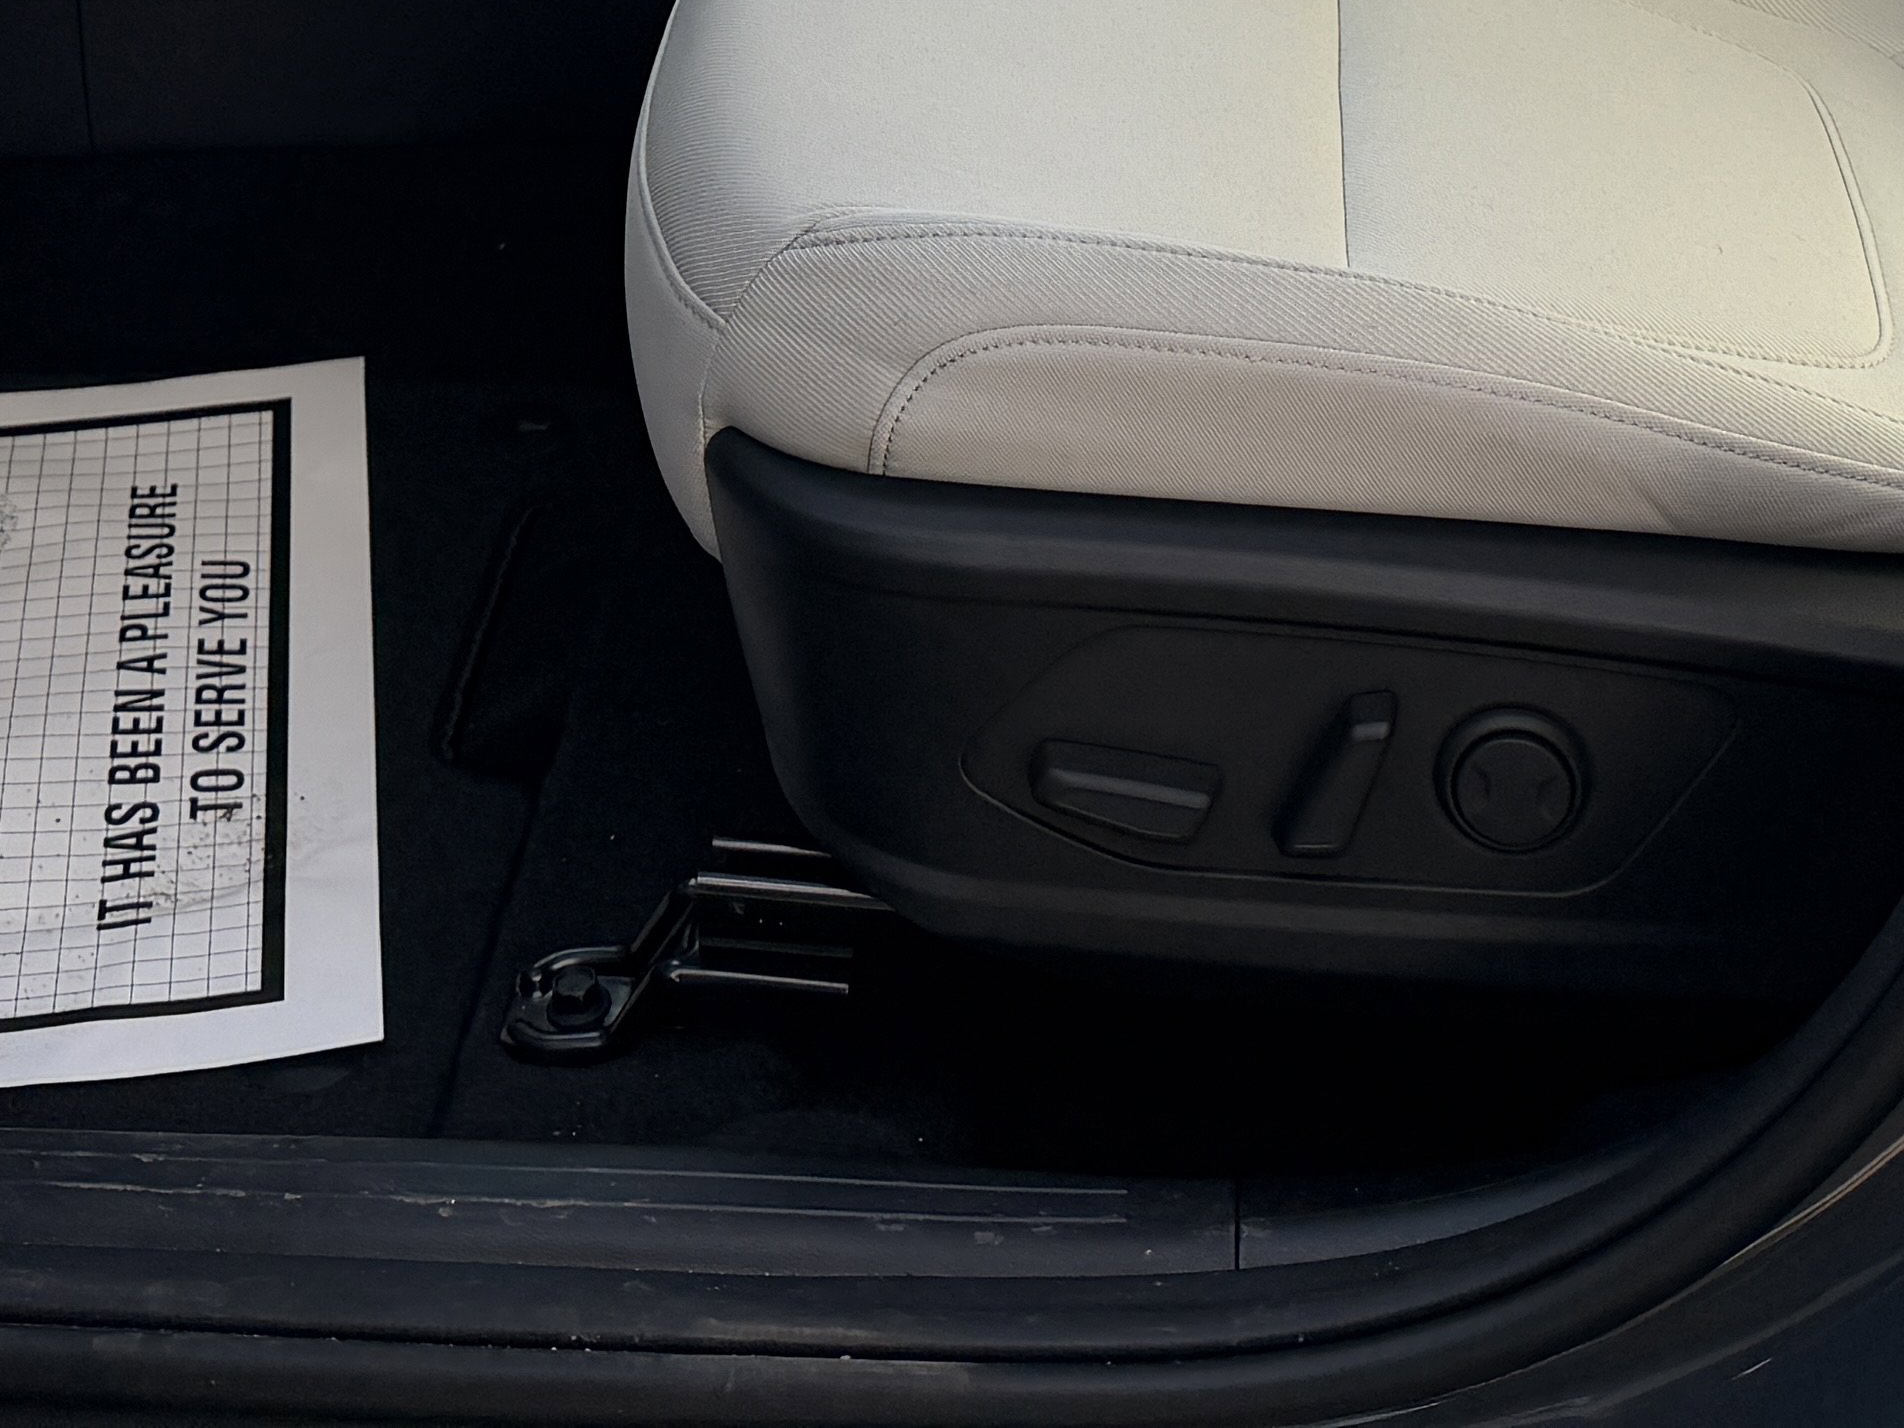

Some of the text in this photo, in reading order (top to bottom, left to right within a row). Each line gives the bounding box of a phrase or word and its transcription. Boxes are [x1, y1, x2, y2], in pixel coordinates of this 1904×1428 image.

[97, 483, 178, 931] IT HAS BEEN A PLEASURE
[189, 559, 251, 821] TO SERVE YOU
